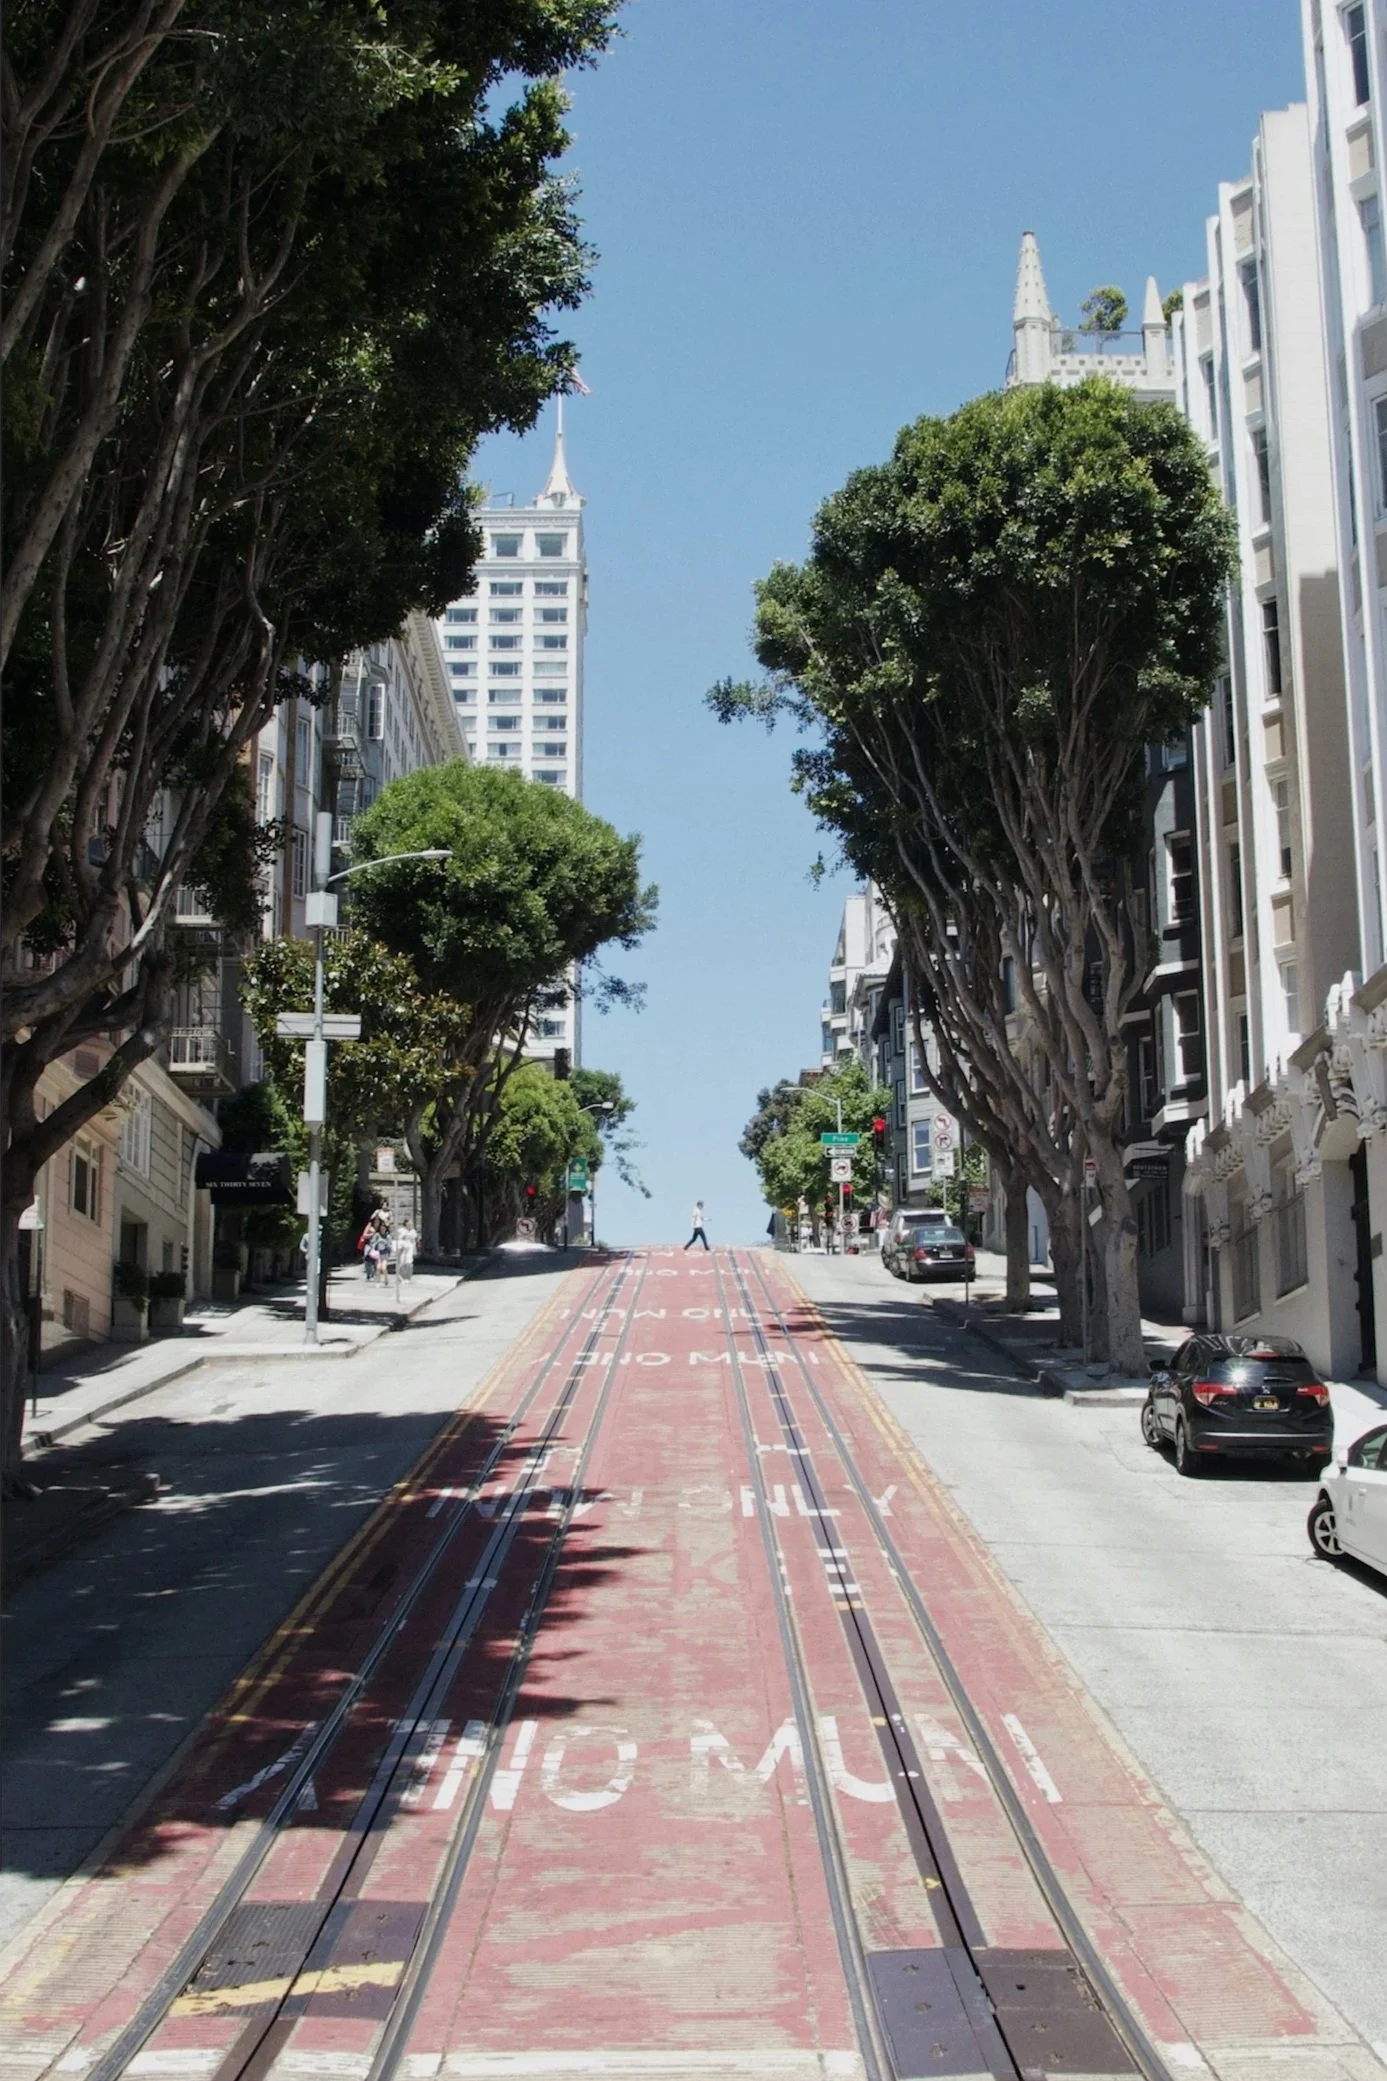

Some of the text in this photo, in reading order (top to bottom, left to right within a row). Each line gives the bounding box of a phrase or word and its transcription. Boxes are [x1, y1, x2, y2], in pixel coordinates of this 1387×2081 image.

[682, 1308, 792, 1320] ONLY
[688, 1351, 820, 1365] MUNI
[677, 1483, 899, 1518] ONLY
[689, 1712, 1065, 1804] MUNI
